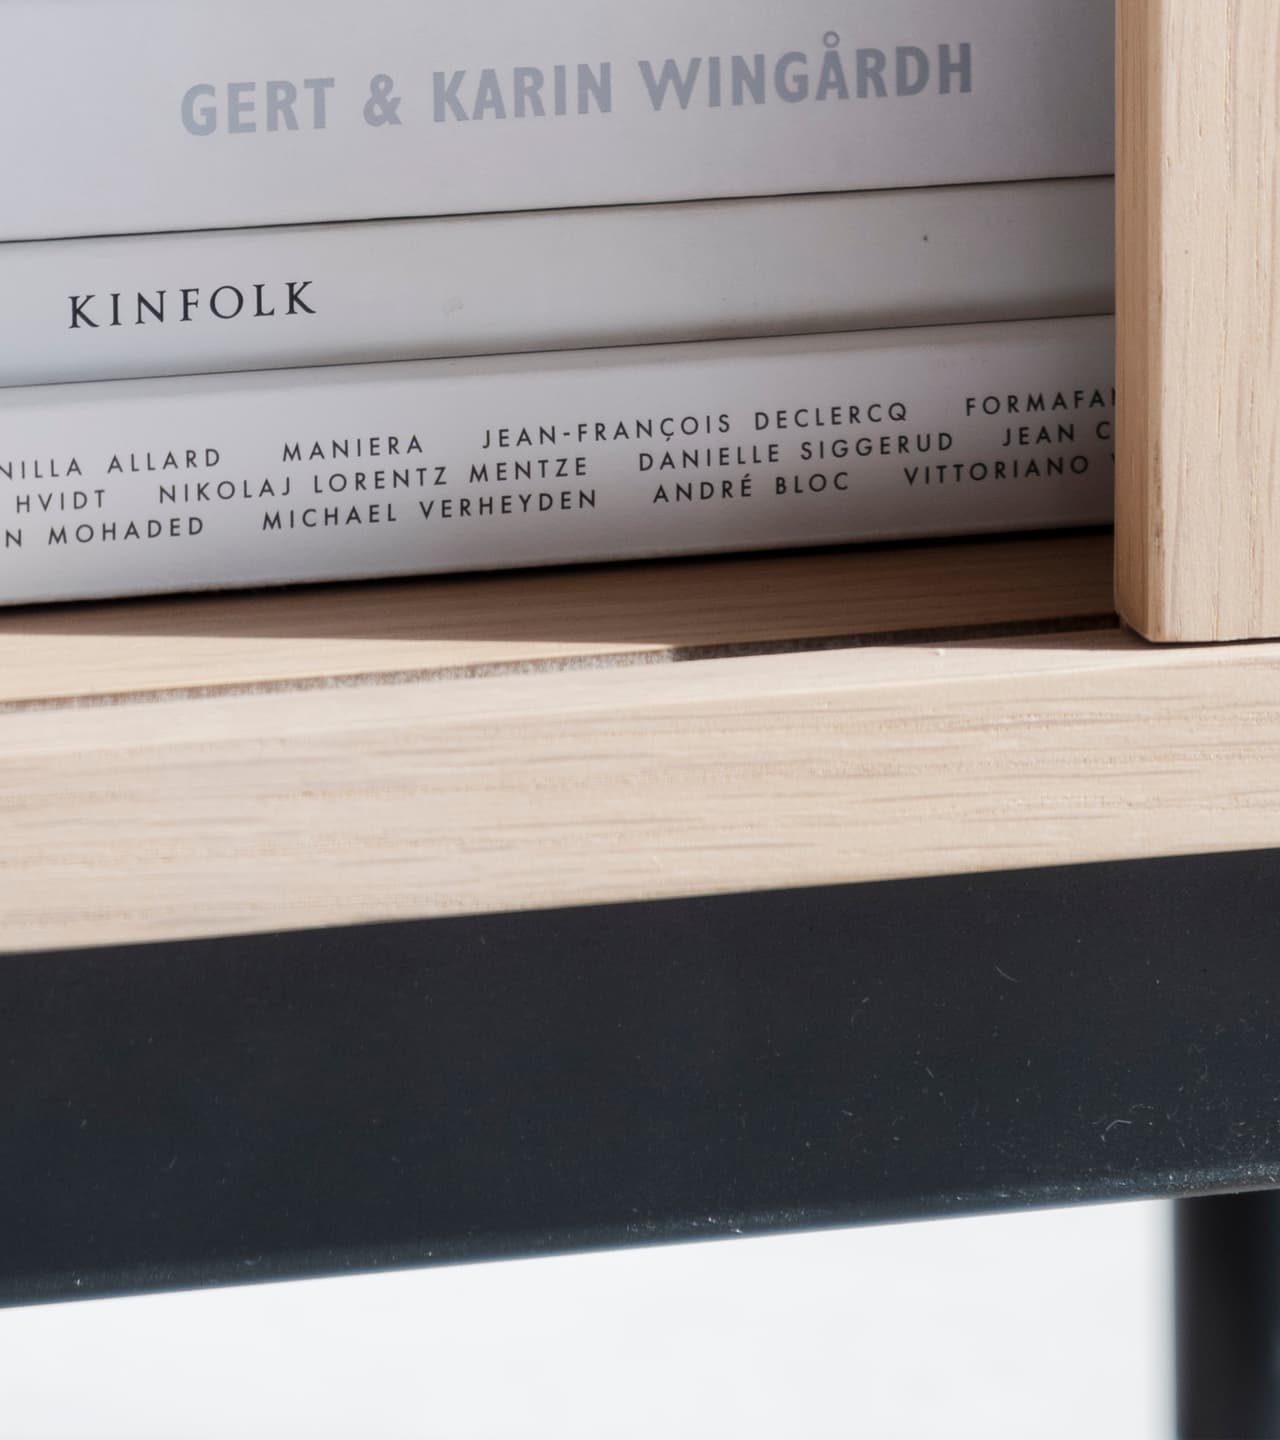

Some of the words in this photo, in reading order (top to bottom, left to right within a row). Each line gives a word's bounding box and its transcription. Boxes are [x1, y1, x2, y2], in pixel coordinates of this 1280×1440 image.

[180, 76, 336, 137] GERT
[362, 73, 402, 128] &
[432, 61, 612, 124] KARIN
[637, 30, 972, 112] WINGÅRDH
[69, 280, 315, 329] KINFOLK
[15, 488, 106, 514] HVIDT
[158, 476, 291, 504] NIKOLAJ
[313, 465, 447, 495] LORENTZ
[468, 456, 586, 484] MENTZE
[638, 443, 779, 472] DANIELLE
[800, 432, 953, 461] SIGGERUD
[1001, 424, 1075, 448] JEAN
[106, 447, 221, 474] ALLARD
[282, 434, 423, 462] MANIERA
[482, 413, 731, 448] JEAN-FRANÇOIS
[754, 401, 907, 432] DECLERCQ
[47, 515, 204, 545] MOHADED
[261, 503, 397, 531] MICHAEL
[418, 489, 596, 520] VERHEYDEN
[652, 473, 752, 504] ANDRÉ
[774, 472, 849, 496] BLOC
[903, 455, 1089, 486] VITTORIANO
